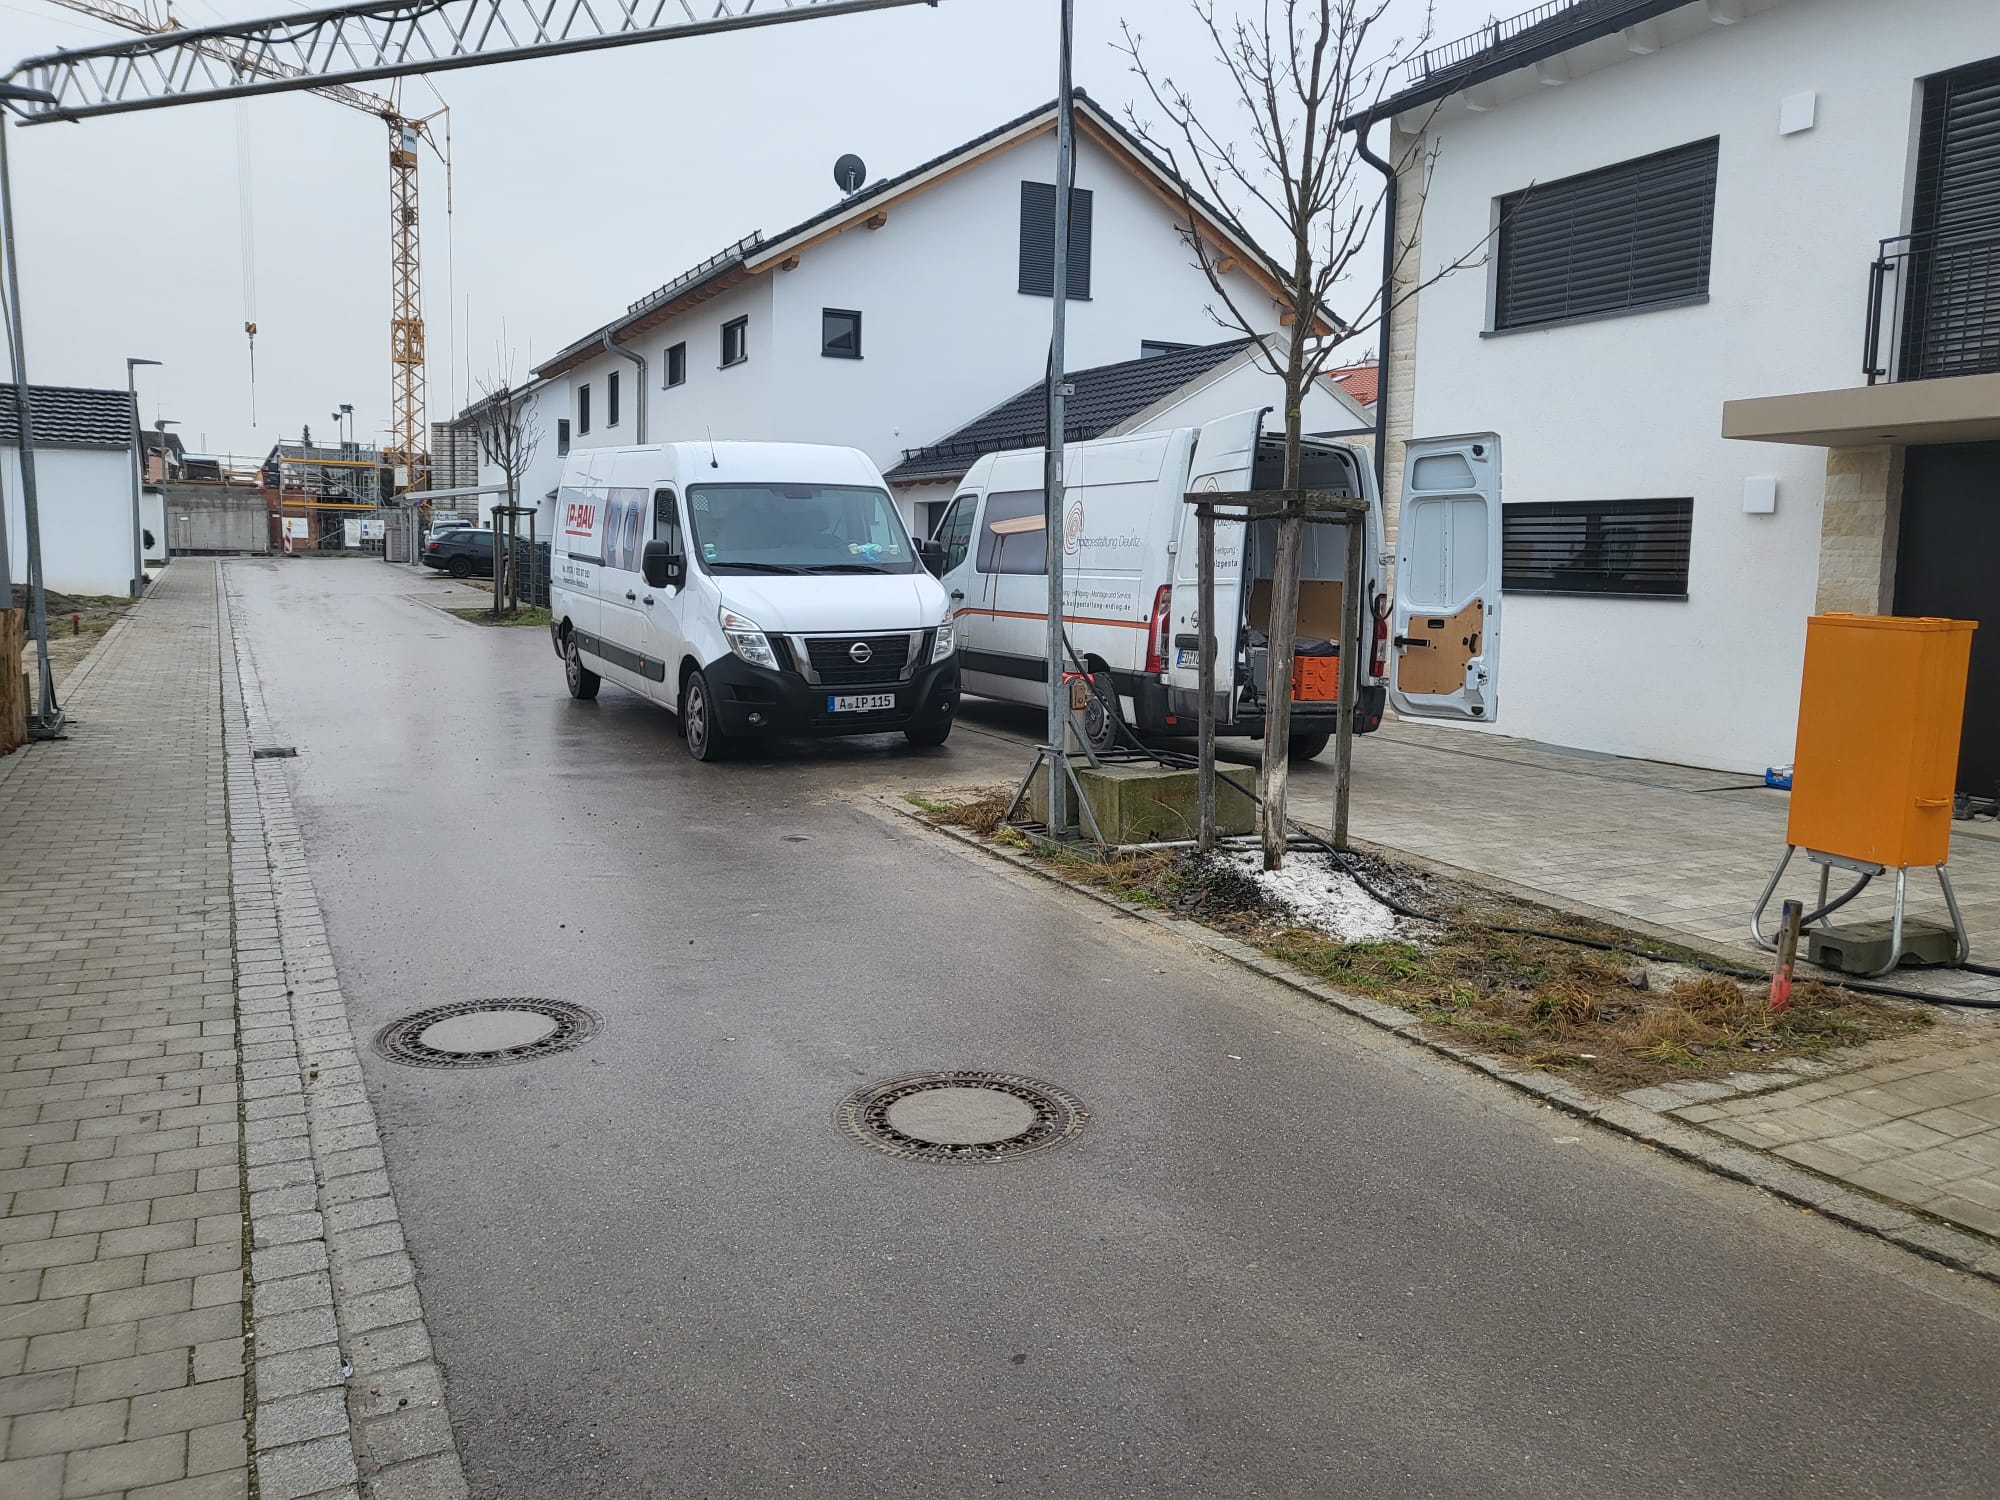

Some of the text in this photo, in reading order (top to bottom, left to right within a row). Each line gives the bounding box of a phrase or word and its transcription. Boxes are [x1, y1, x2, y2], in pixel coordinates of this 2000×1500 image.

[566, 503, 595, 530] IP-BAU
[840, 698, 846, 709] A
[855, 697, 868, 708] IP
[871, 696, 891, 708] 115
